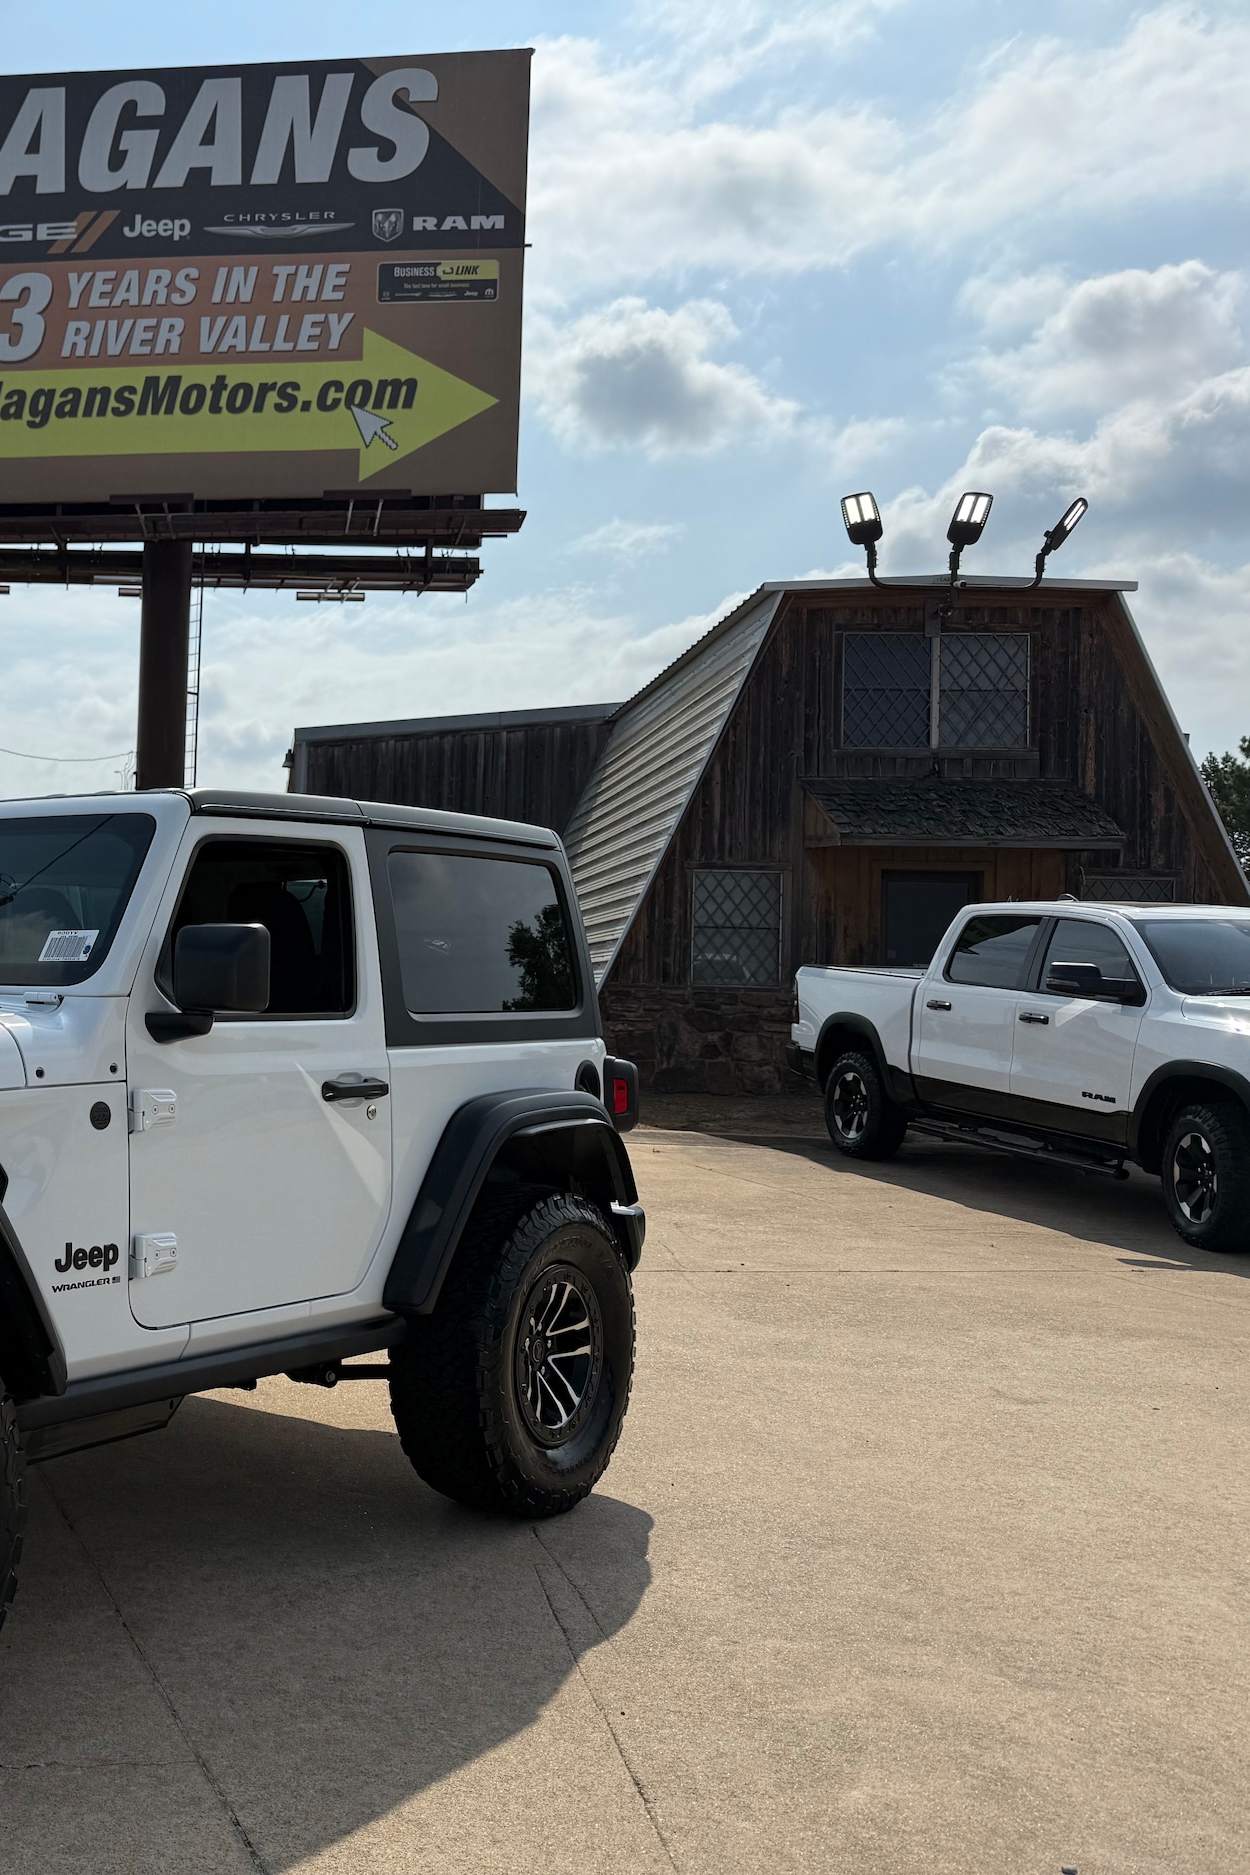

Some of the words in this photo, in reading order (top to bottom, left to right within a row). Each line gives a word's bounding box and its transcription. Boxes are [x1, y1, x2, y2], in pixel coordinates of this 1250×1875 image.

[223, 211, 336, 223] CHRYSLER
[412, 214, 505, 231] RAM
[123, 214, 191, 241] Jeep
[393, 266, 435, 277] BUSINESS
[454, 265, 480, 276] LINK
[67, 267, 200, 309] YEARS
[210, 266, 260, 304] IN
[271, 263, 352, 303] THE
[60, 317, 185, 358] RIVER
[199, 313, 355, 354] VALLEY
[1081, 1091, 1116, 1104] RAM
[54, 1242, 119, 1273] Jeep
[51, 1277, 110, 1293] WRANGLER
